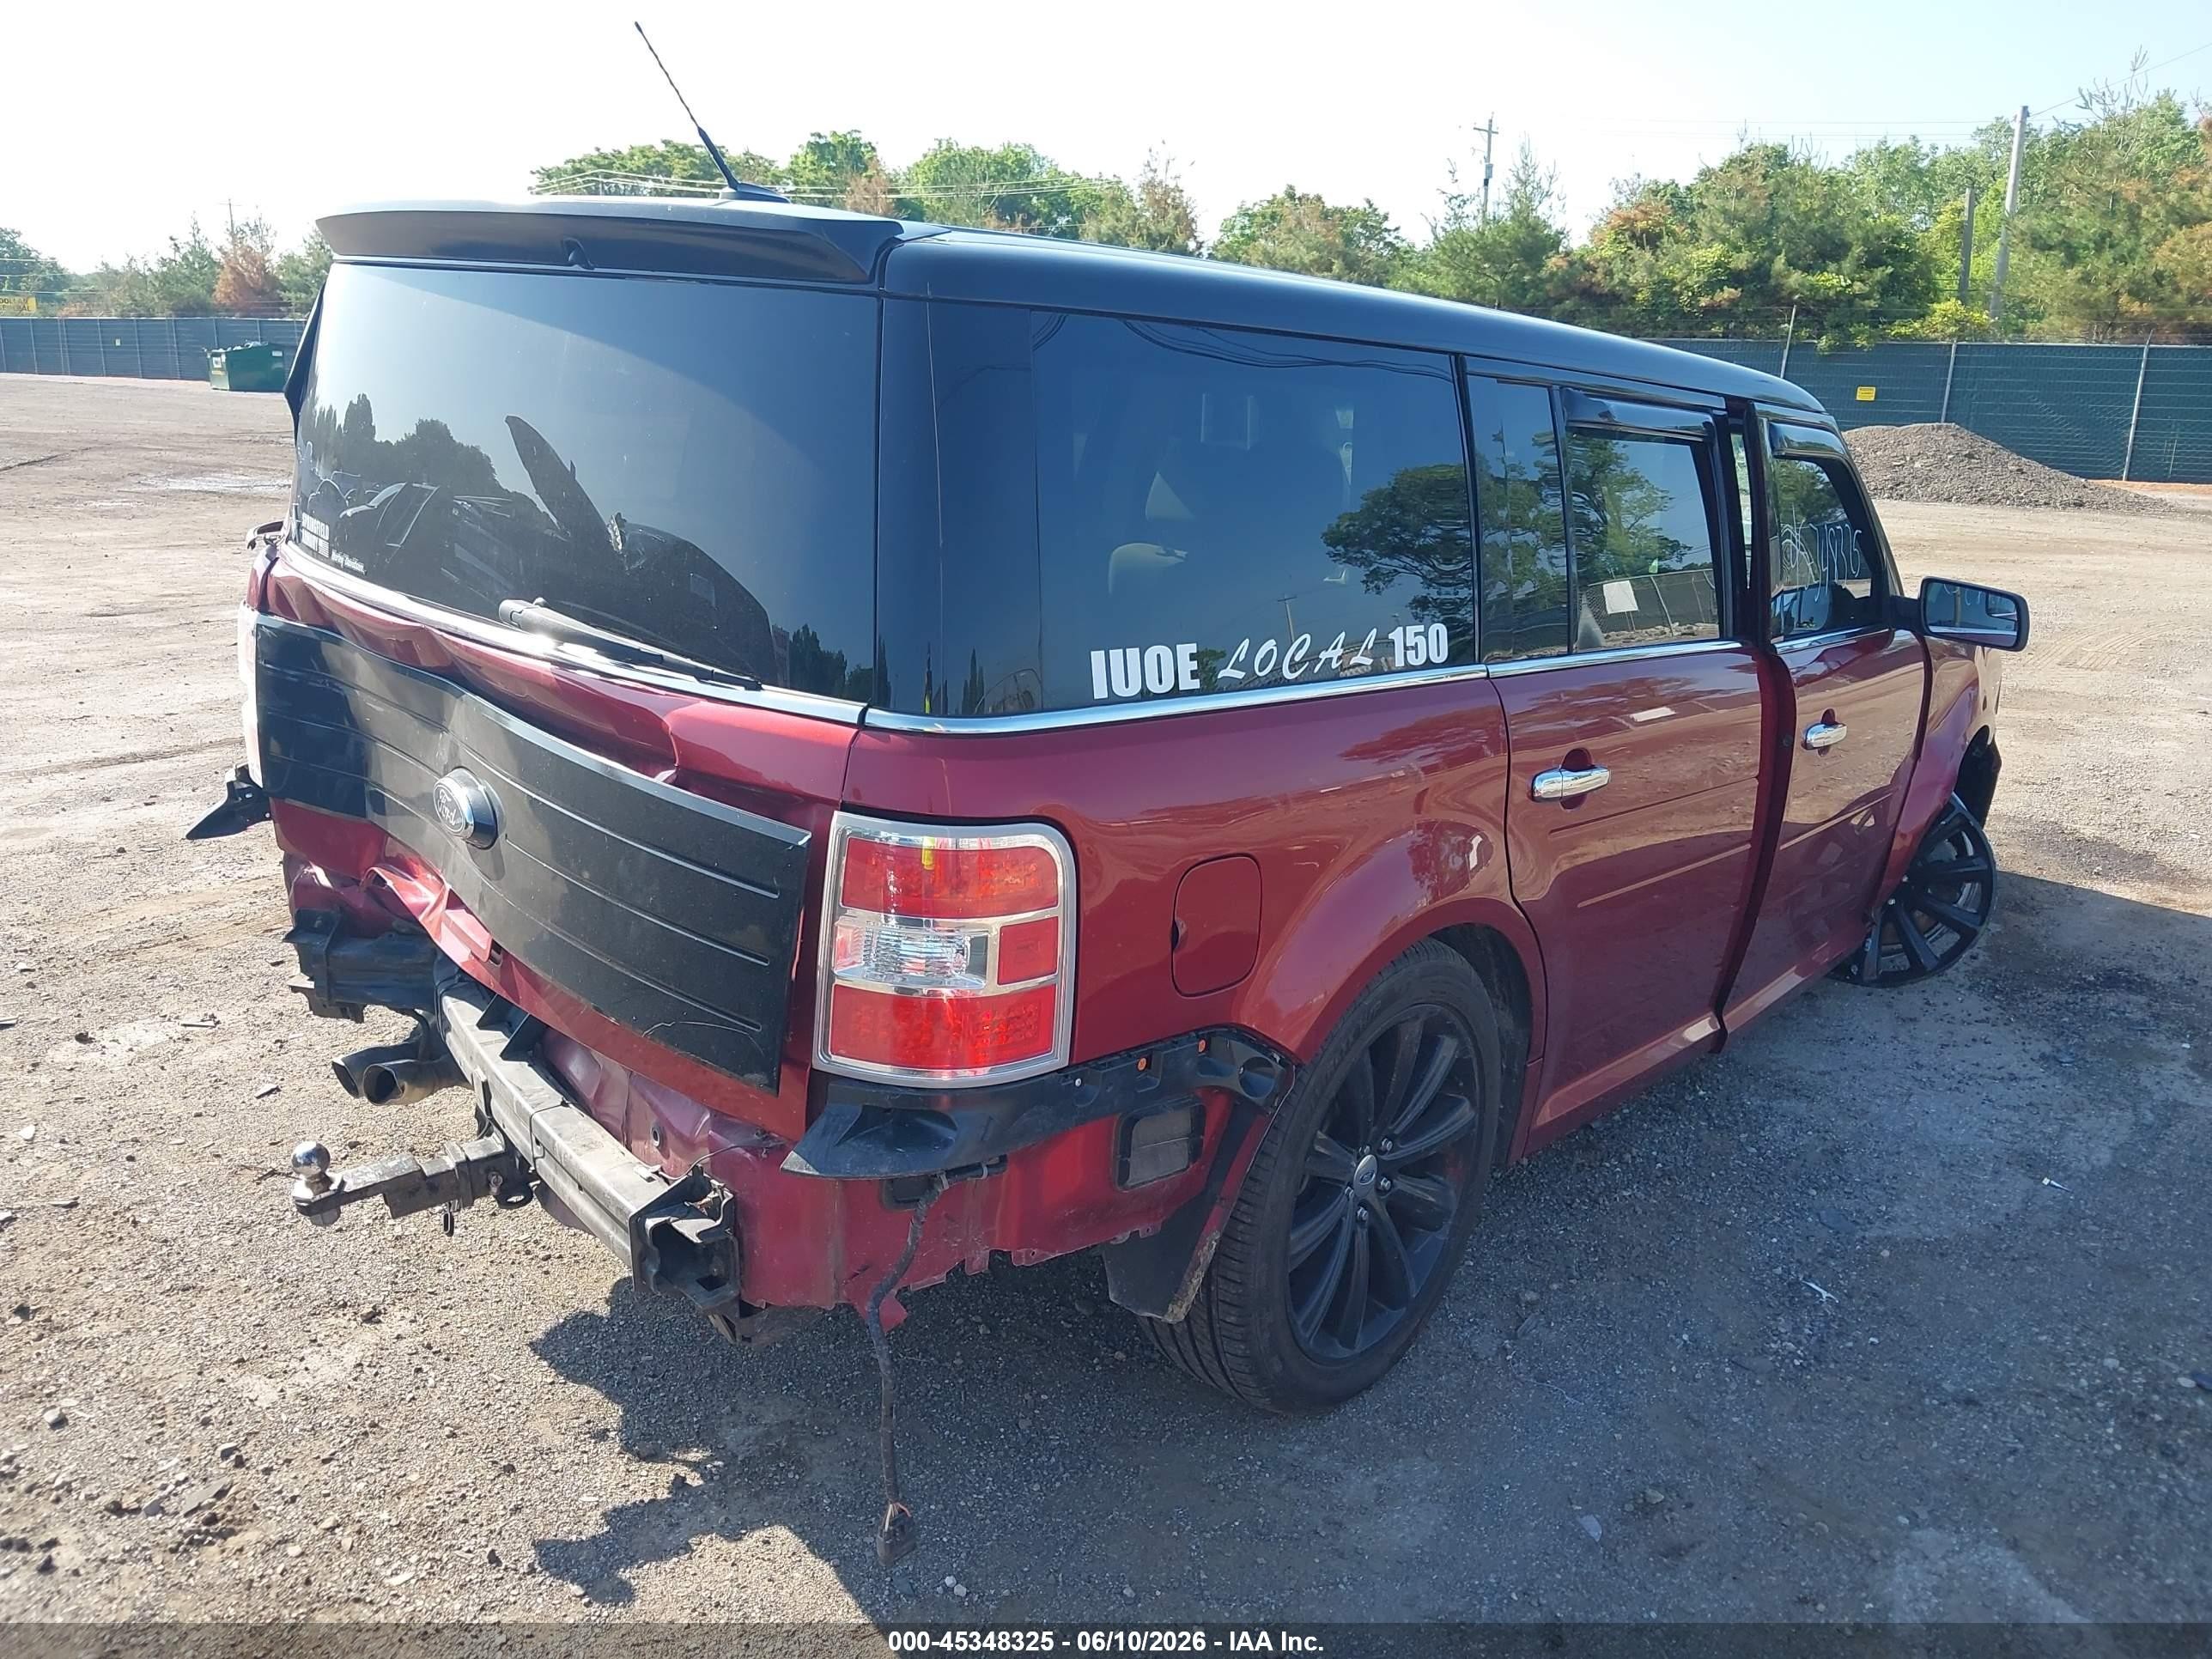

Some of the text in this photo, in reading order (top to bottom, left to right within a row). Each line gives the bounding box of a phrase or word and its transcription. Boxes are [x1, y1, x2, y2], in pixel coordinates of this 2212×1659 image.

[1091, 623, 1448, 699] IUOE LOCAL 150
[438, 789, 456, 825] Ford
